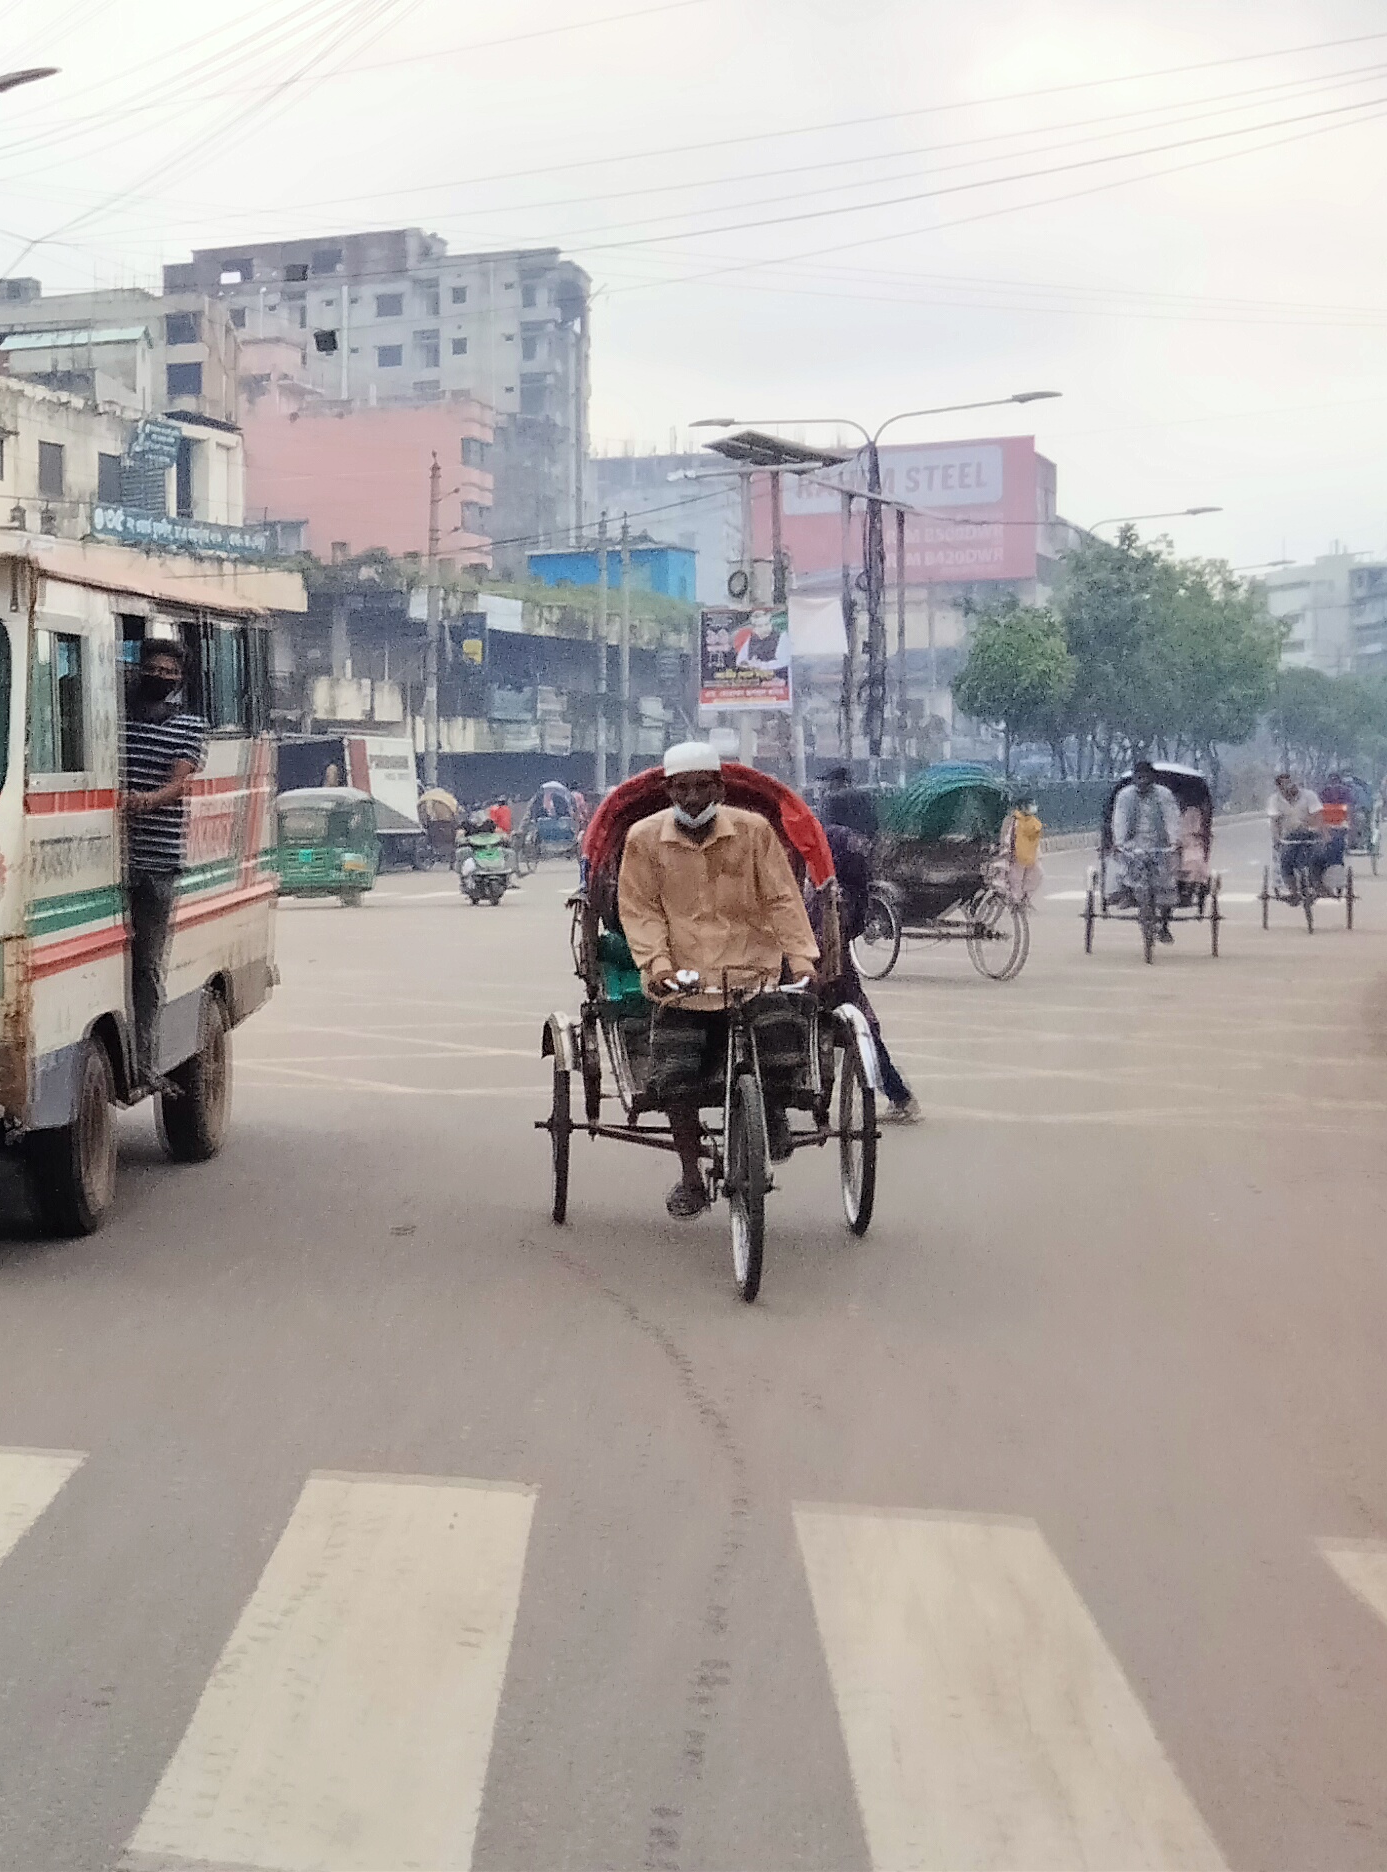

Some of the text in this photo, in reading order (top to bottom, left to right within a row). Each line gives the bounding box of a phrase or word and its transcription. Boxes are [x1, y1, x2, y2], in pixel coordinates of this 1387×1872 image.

[905, 461, 988, 493] STEEL
[886, 529, 920, 545] RM
[886, 552, 921, 568] RM
